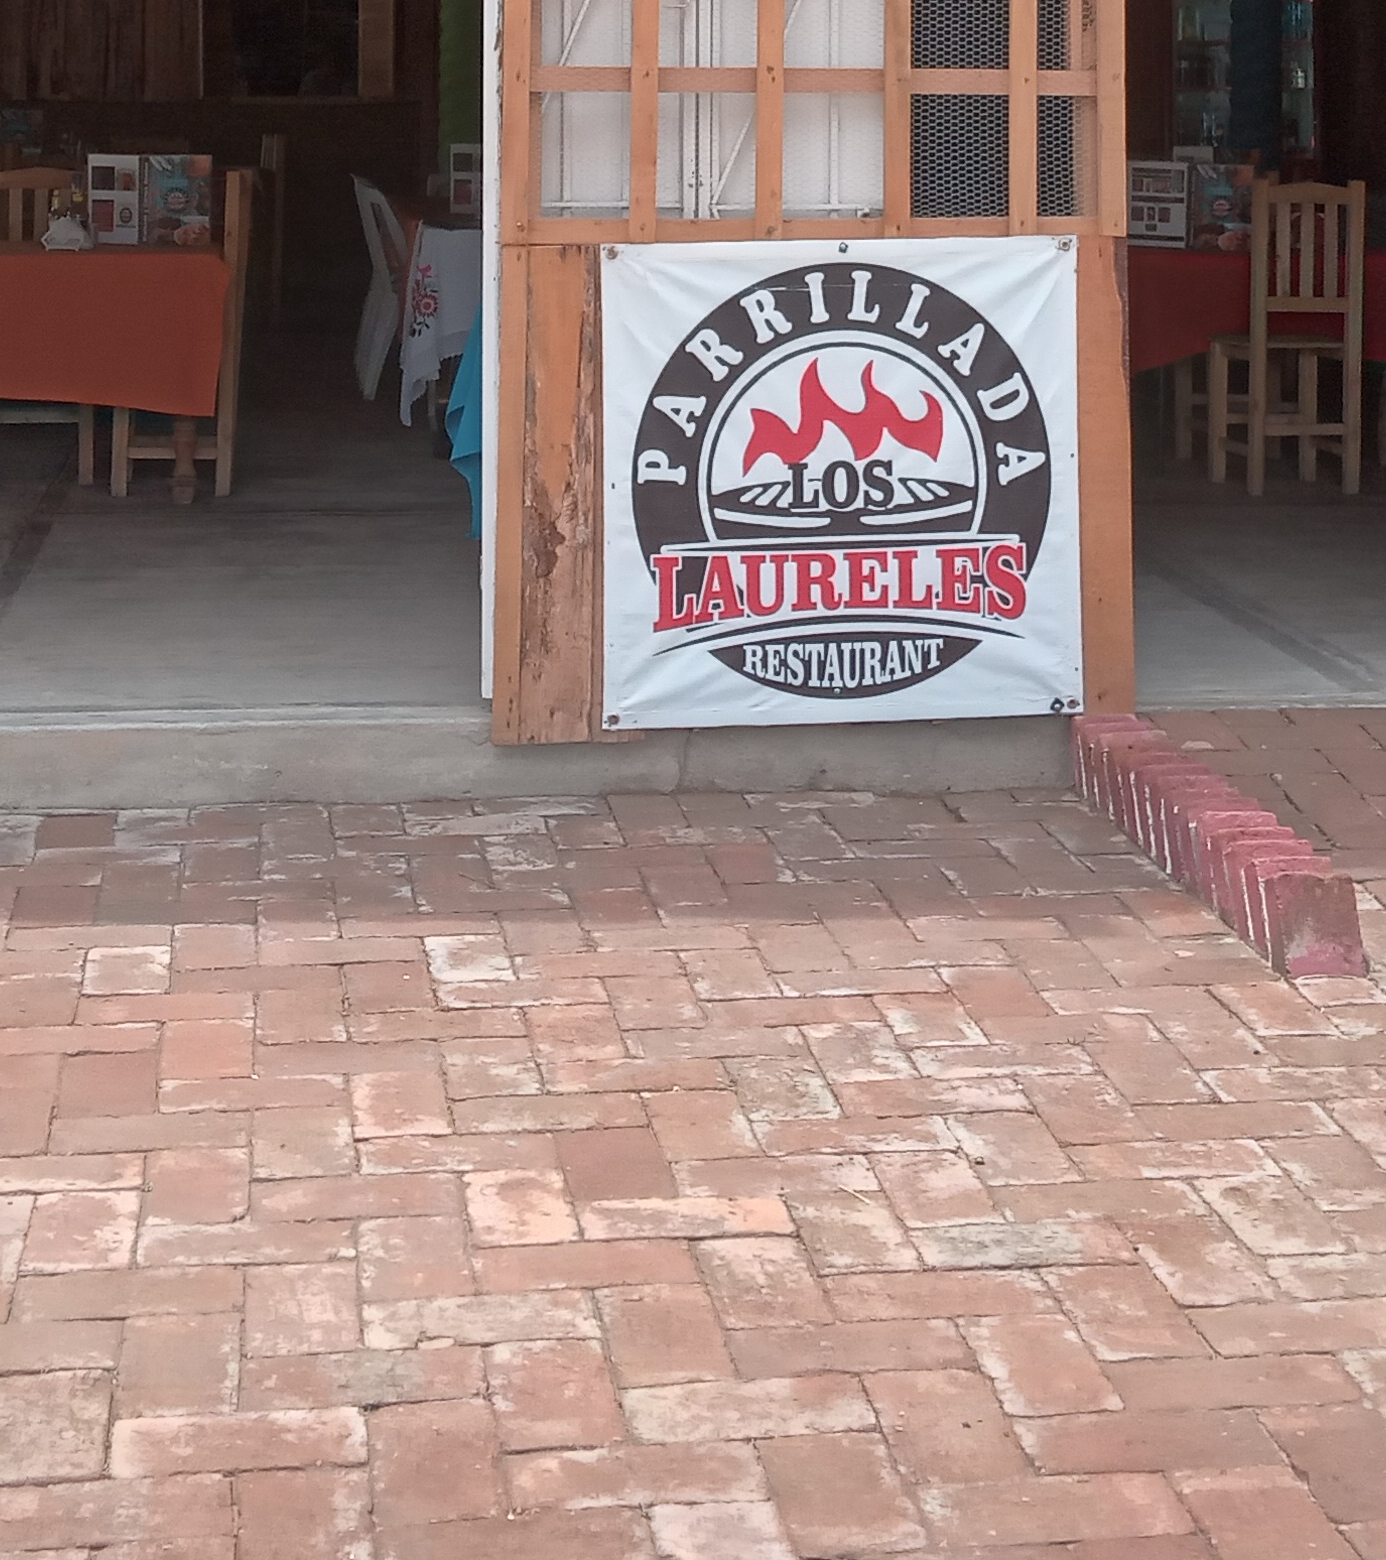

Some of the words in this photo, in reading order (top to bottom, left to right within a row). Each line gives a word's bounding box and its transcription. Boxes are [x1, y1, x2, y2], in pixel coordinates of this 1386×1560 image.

[637, 269, 1046, 487] PARRILLADA
[788, 460, 900, 511] LOS
[651, 542, 1030, 634] LAURELES
[742, 638, 945, 689] RESTAURANT
